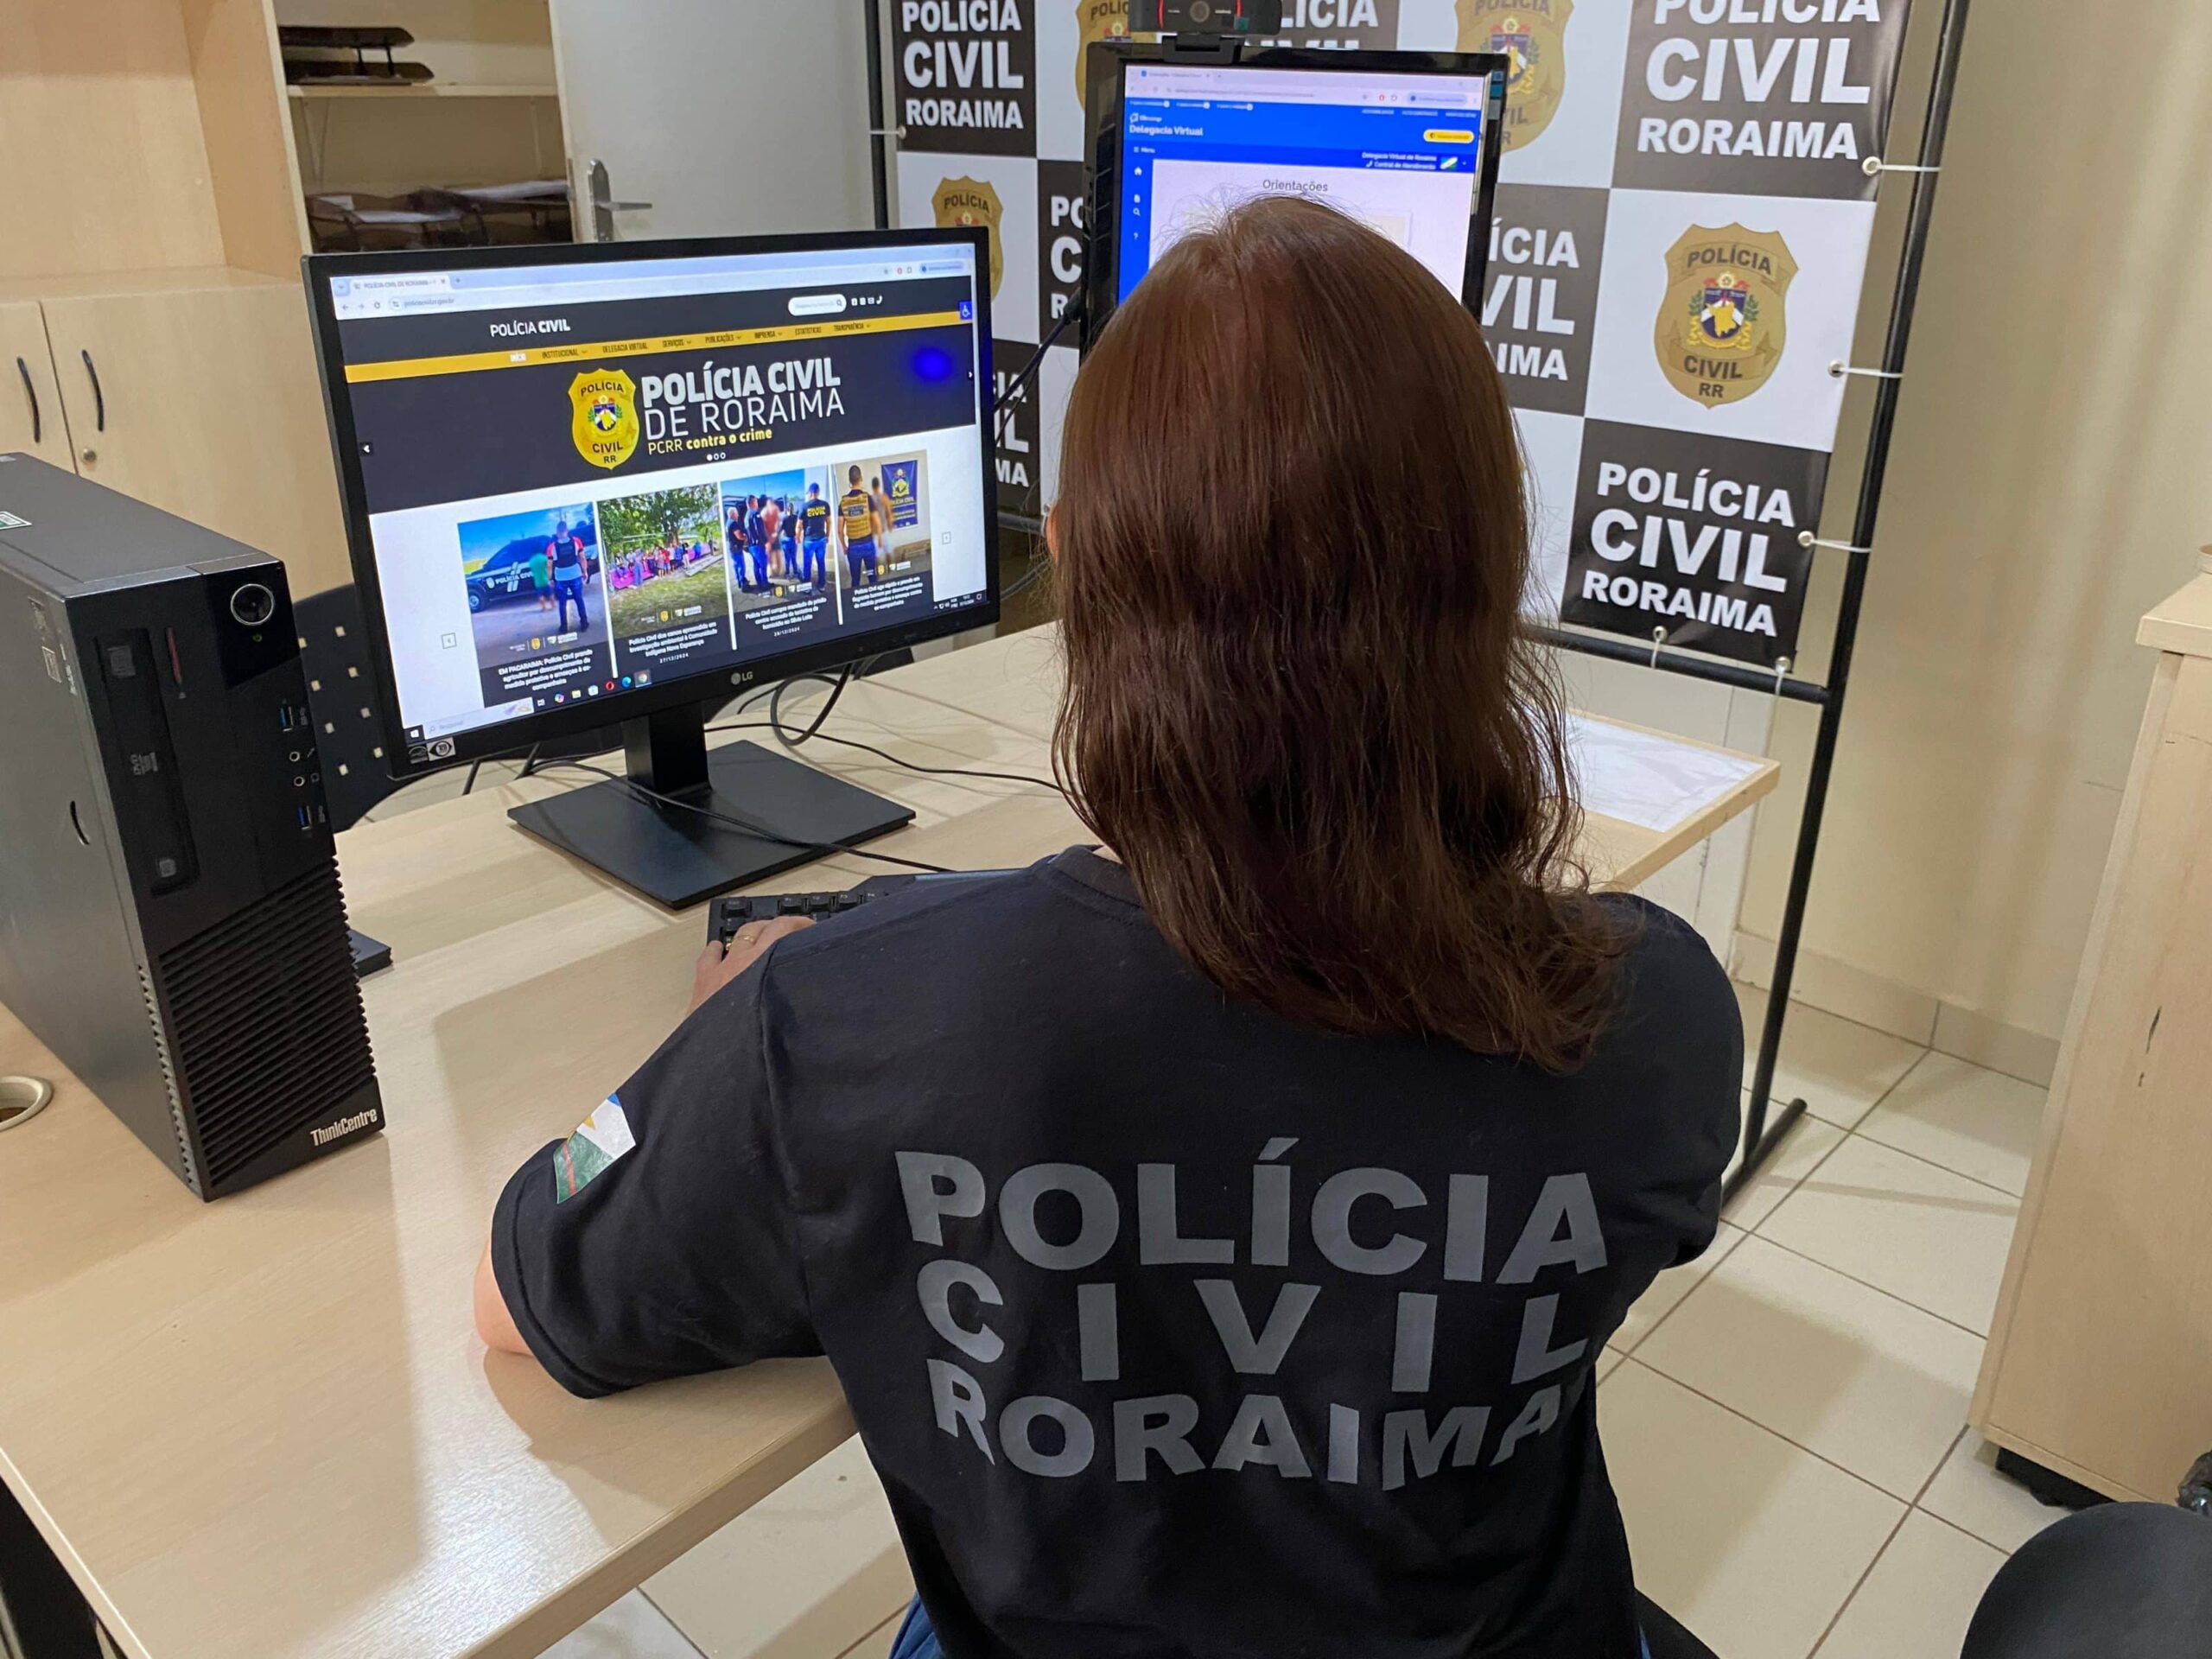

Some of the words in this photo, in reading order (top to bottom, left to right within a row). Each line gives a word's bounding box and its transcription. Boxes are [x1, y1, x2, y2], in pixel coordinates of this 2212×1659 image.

[904, 41, 1024, 89] CIVIL
[1645, 37, 1871, 104] CIVIL
[906, 99, 1024, 129] RORAIMA
[1129, 124, 1173, 136] Delegacia
[1174, 125, 1204, 136] Virtual
[1637, 118, 1859, 160] RORAIMA
[1489, 217, 1580, 269] ÍCIA
[1687, 245, 1772, 276] POLÍCIA
[490, 320, 537, 337] POLÍCIA
[538, 319, 570, 333] CIVIL
[641, 361, 765, 408] POLÍCIA
[767, 357, 841, 392] CIVIL
[1683, 354, 1743, 380] CIVIL
[1699, 383, 1724, 398] RR
[645, 406, 689, 441] DE
[701, 388, 845, 433] RORAIMA
[592, 442, 624, 453] CIVIL
[648, 440, 683, 455] PCRR
[686, 435, 727, 450] contra
[728, 434, 737, 444] o
[740, 429, 772, 442] crime
[1597, 462, 1795, 527] POLÍCIA
[1590, 509, 1788, 593] CIVIL
[1582, 569, 1777, 638] RORAIMA
[741, 671, 753, 682] LG
[310, 1108, 378, 1147] ThinkCentre
[894, 1136, 1608, 1284] POLÍCIA
[916, 1259, 1590, 1393] CIVIL
[926, 1358, 1561, 1491] RORAIMA
